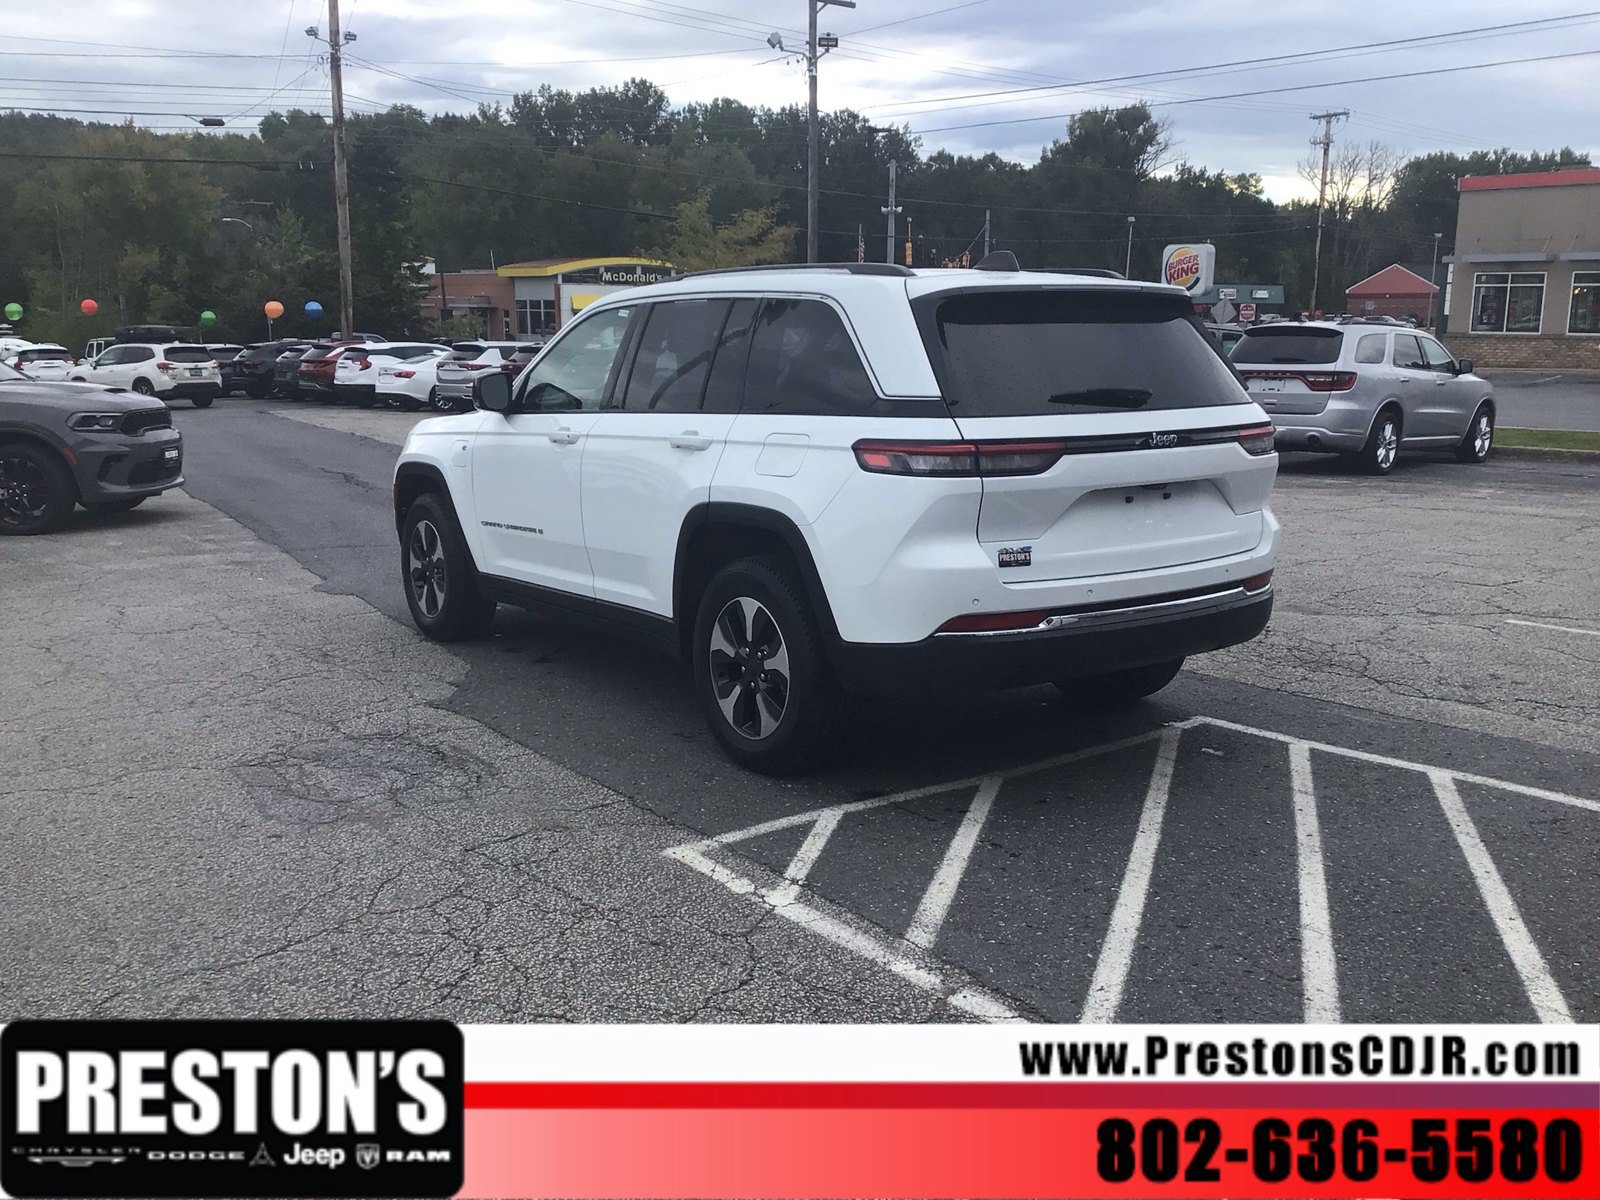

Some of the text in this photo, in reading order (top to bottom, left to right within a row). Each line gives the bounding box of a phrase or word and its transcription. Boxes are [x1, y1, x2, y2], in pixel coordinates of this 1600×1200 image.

[1168, 254, 1199, 272] BURGER
[602, 271, 662, 282] McDonald's
[1168, 262, 1200, 283] KING
[1149, 432, 1178, 447] Jeep
